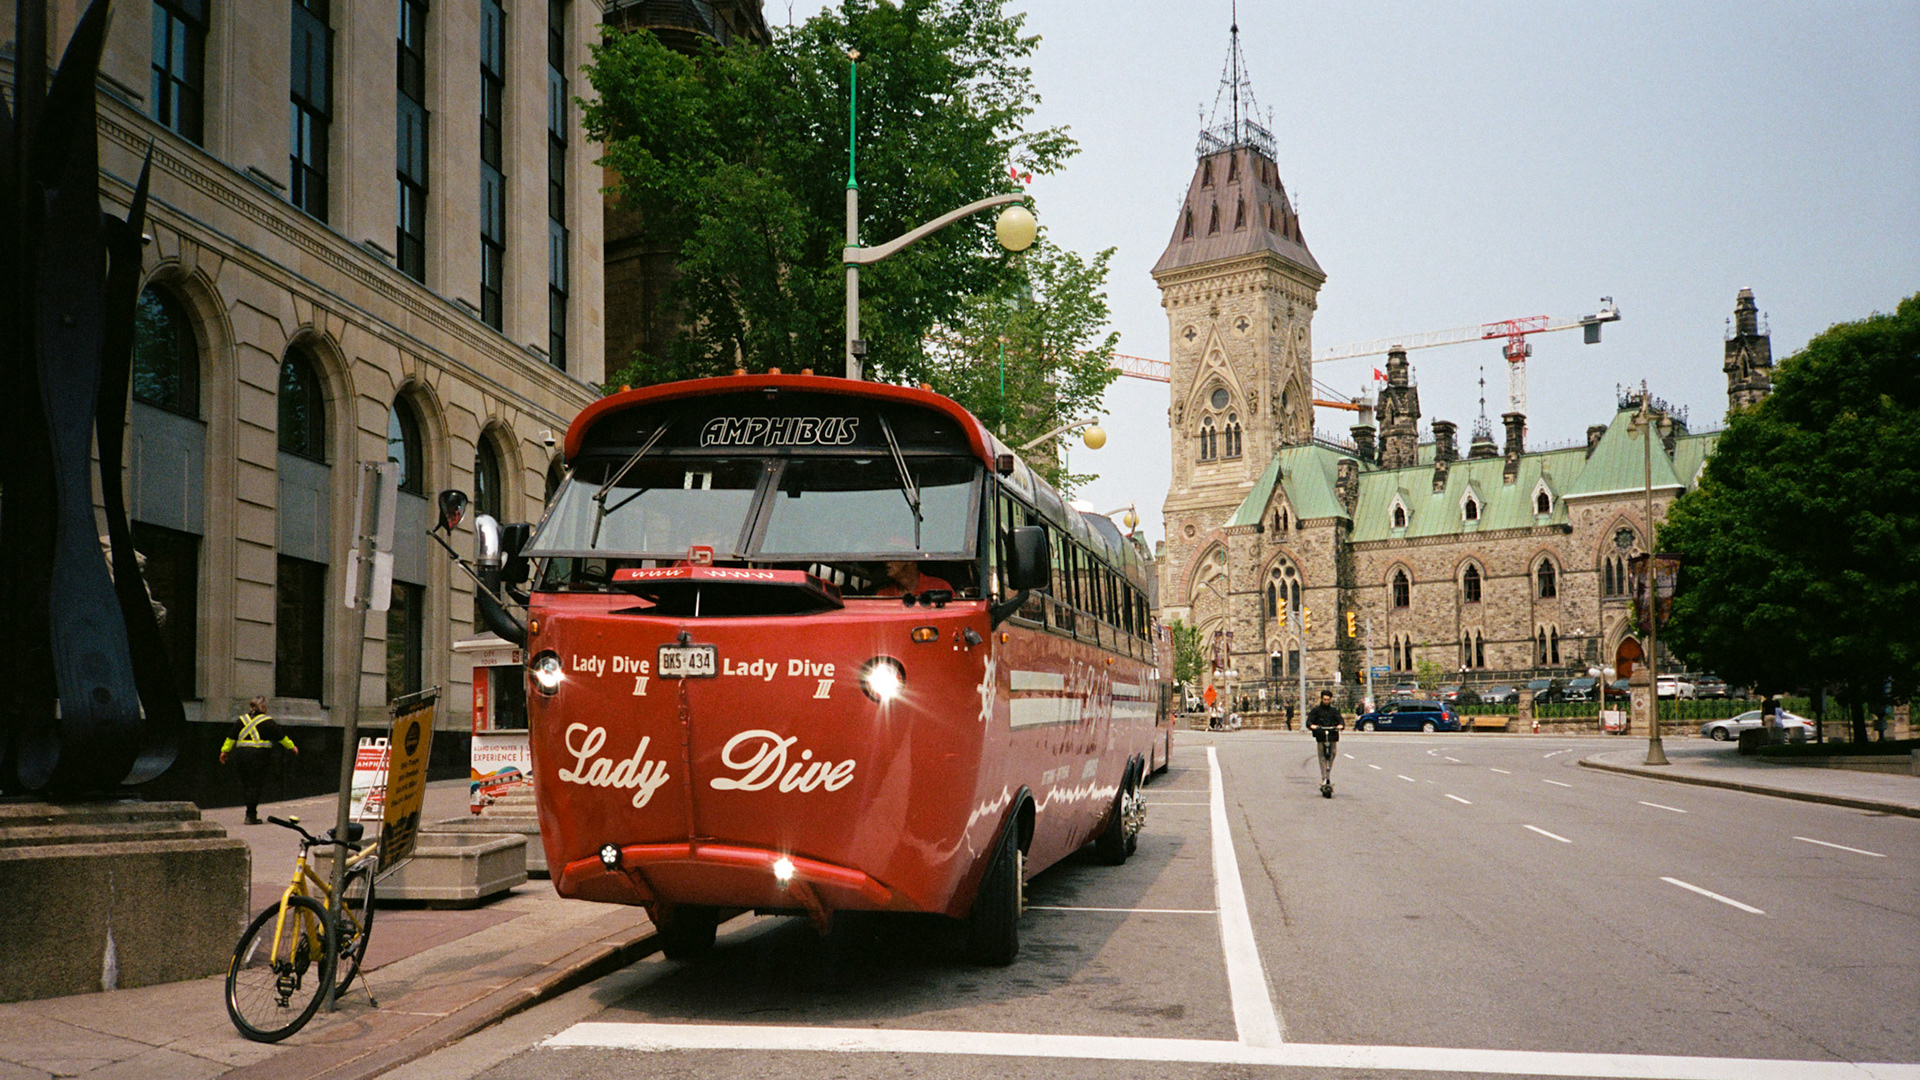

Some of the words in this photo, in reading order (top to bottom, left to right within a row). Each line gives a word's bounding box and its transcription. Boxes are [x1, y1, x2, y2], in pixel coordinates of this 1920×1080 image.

[700, 417, 859, 448] AMPHIBUS
[572, 655, 606, 677] Lady
[612, 656, 650, 674] Dive
[688, 653, 711, 669] 434
[723, 658, 779, 682] Lady
[787, 658, 836, 677] Dive
[633, 677, 649, 696] III
[812, 679, 835, 699] III
[473, 752, 518, 762] EXPERIENCE
[558, 722, 670, 809] Lady
[709, 729, 856, 794] Dive
